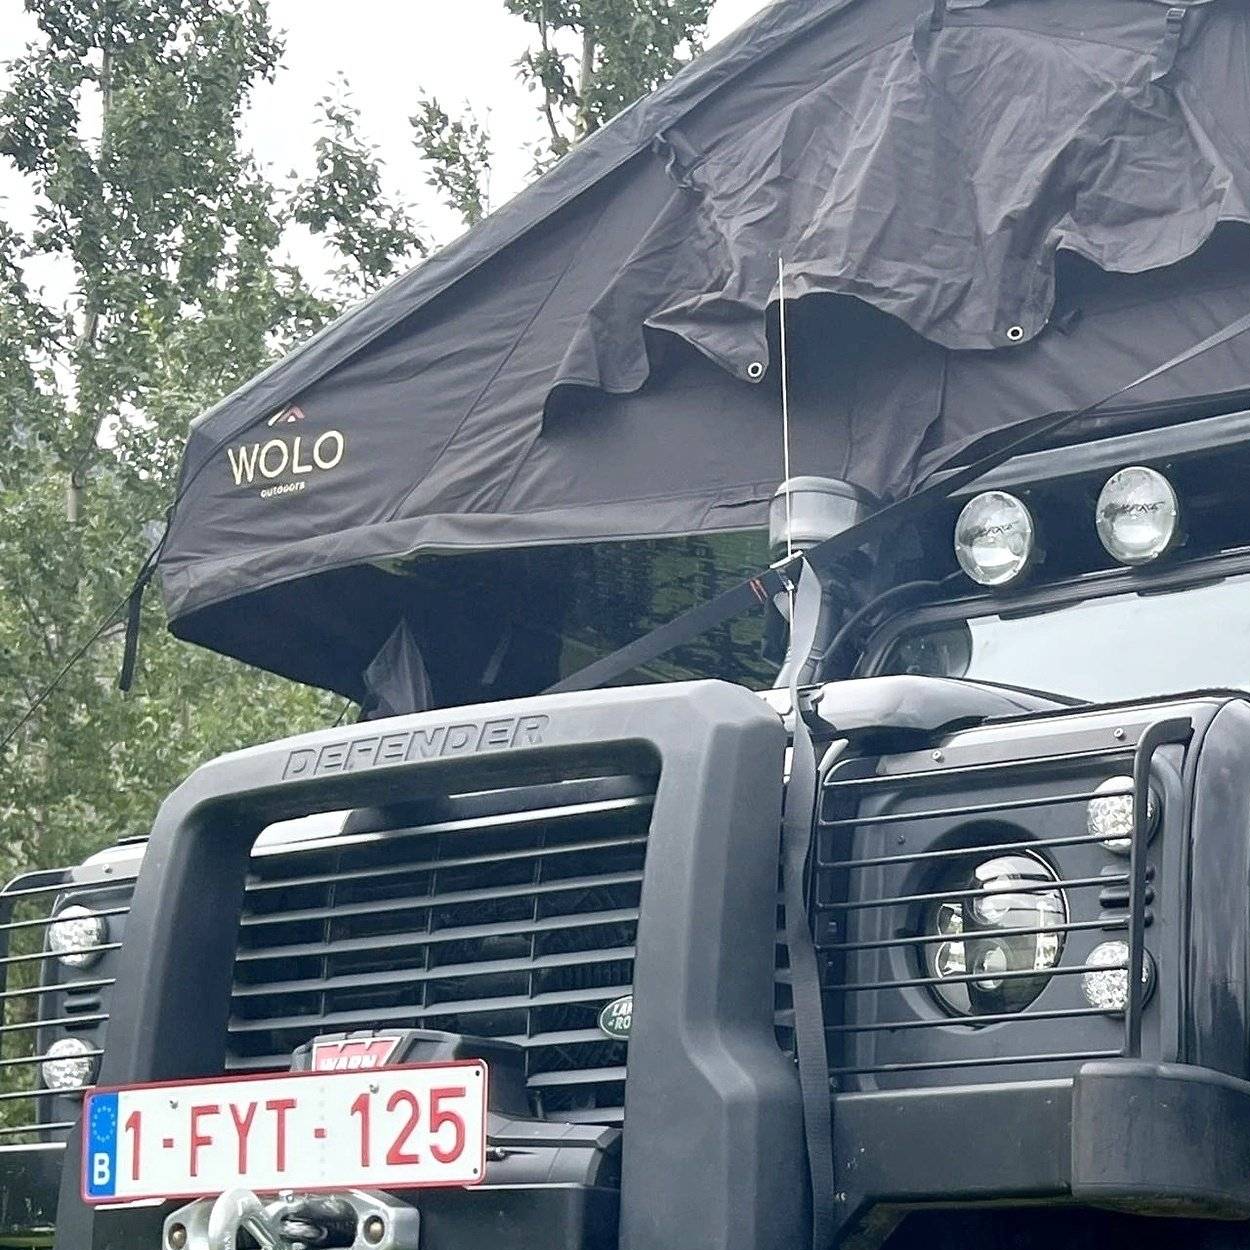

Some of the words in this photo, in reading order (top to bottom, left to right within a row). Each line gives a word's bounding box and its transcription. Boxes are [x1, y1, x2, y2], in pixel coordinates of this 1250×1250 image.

[227, 430, 344, 486] WOLO
[281, 714, 551, 781] DEFENDER
[320, 1054, 378, 1071] WARN
[93, 1152, 110, 1185] B
